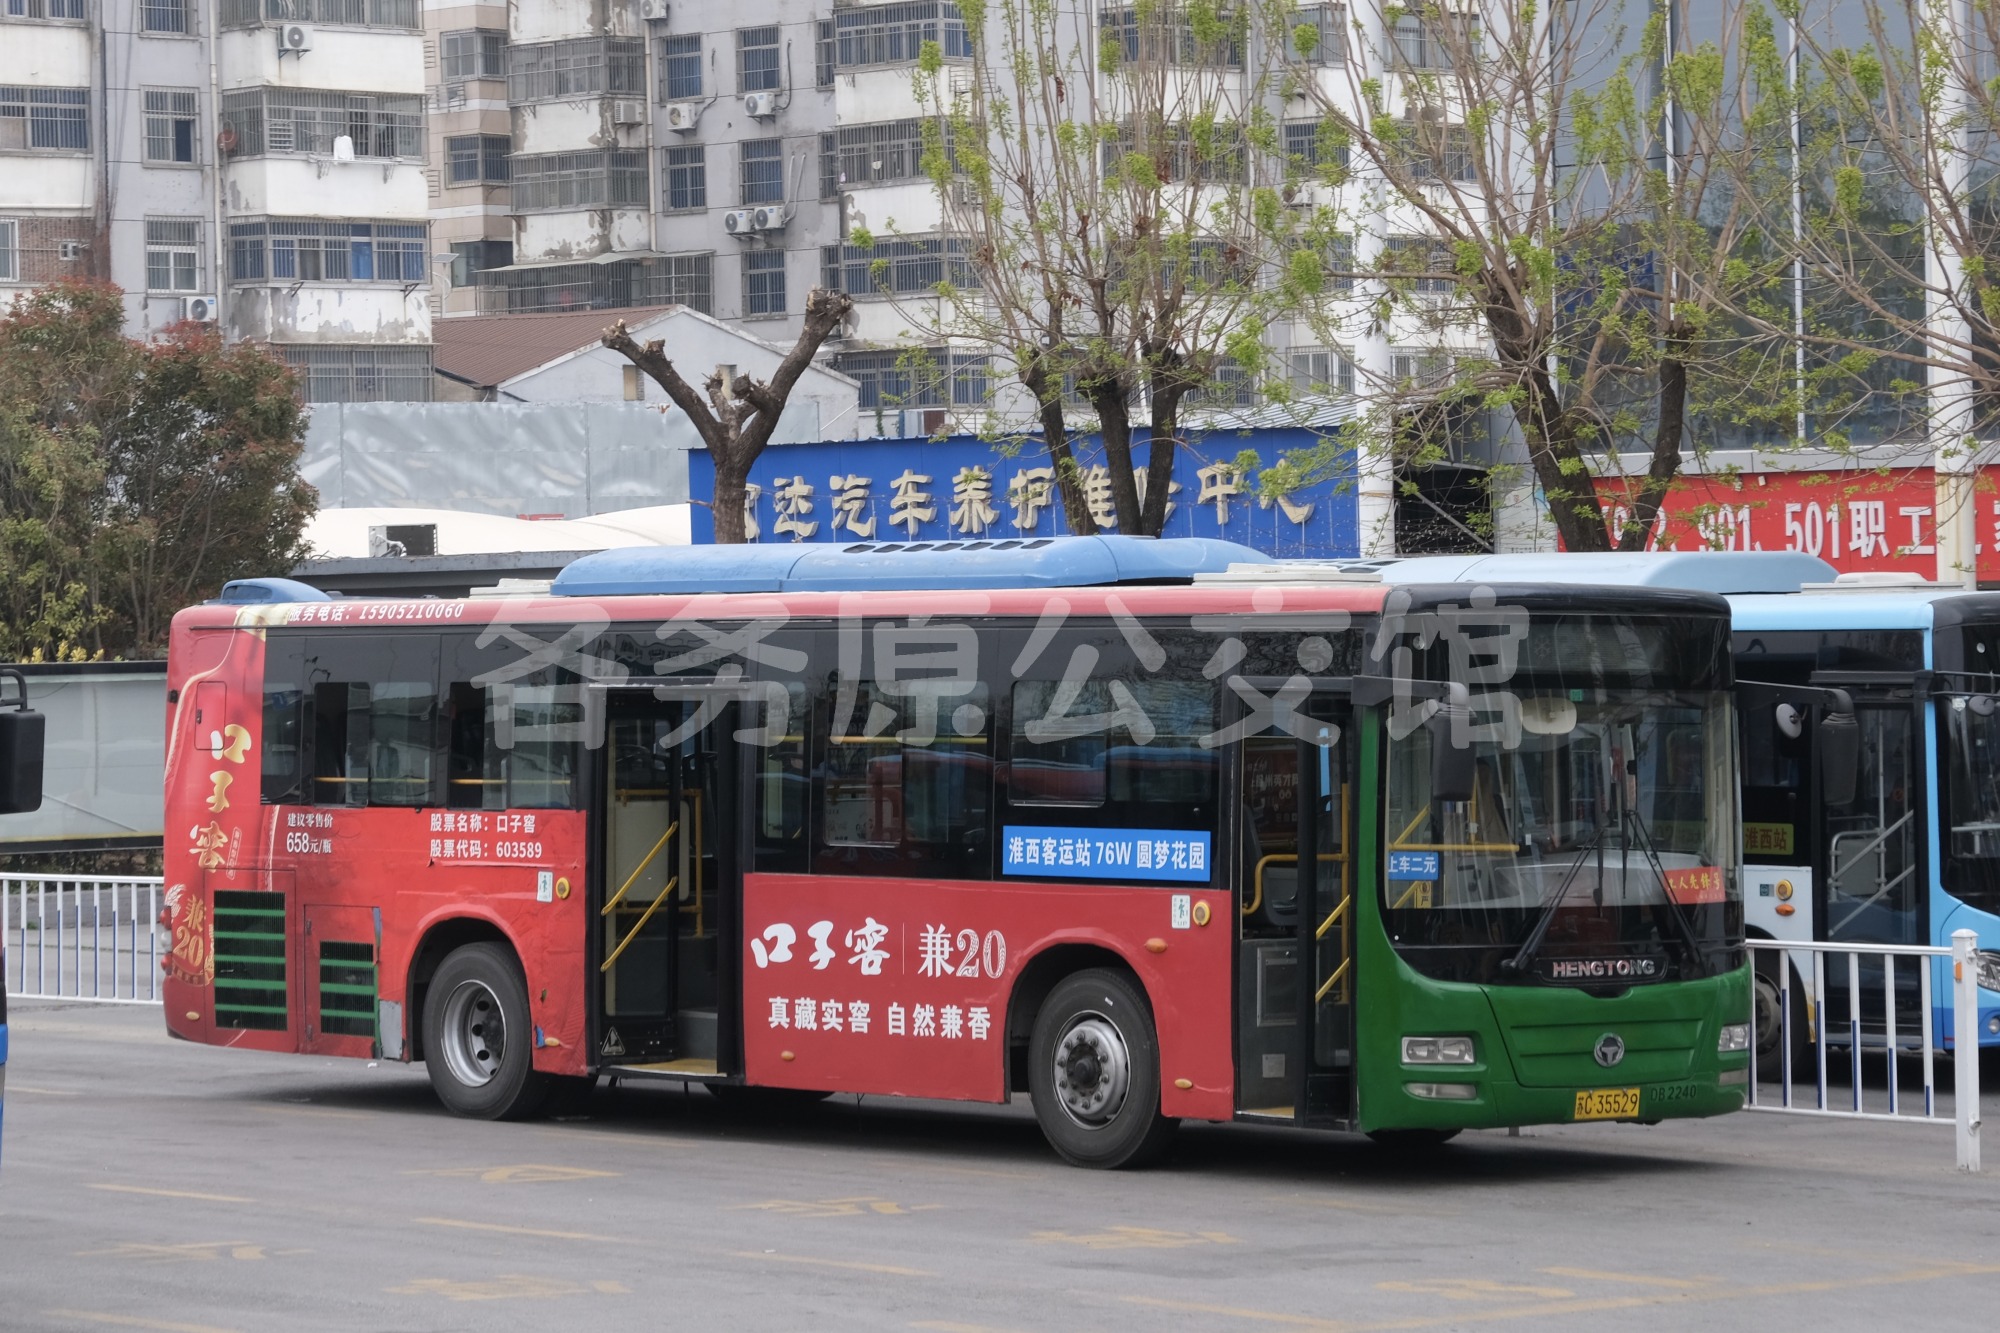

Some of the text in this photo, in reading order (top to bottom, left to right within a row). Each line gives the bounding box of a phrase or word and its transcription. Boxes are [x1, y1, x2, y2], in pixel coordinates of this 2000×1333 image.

[287, 812, 334, 828] 建议零售价
[286, 831, 333, 855] 658元/瓶
[1745, 827, 1788, 851] 淮西站
[1008, 836, 1205, 870] 淮西客运站 76W 圆梦花园
[1388, 855, 1436, 874] 上车二元
[750, 917, 1007, 979] 口子窖 兼20
[1552, 959, 1655, 978] HENGTONG
[767, 995, 991, 1041] 真藏实窖 自然兼香
